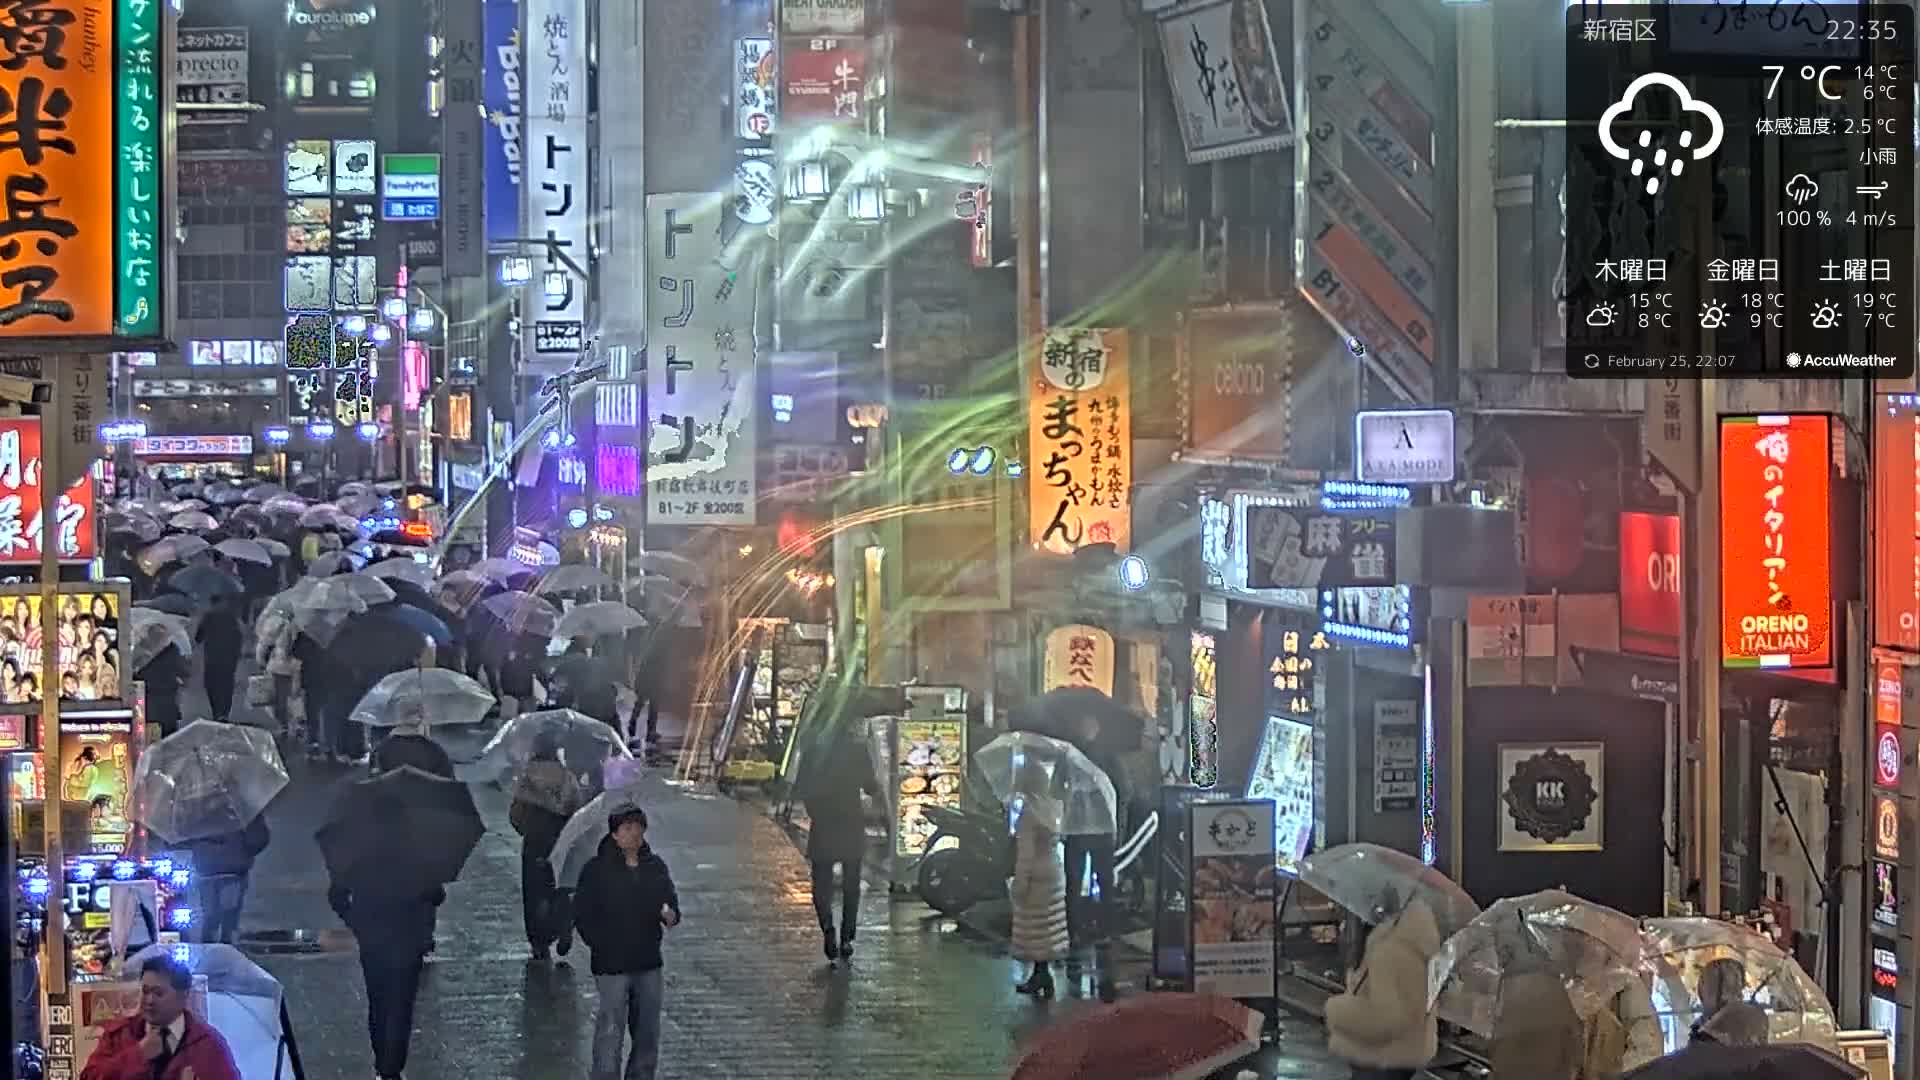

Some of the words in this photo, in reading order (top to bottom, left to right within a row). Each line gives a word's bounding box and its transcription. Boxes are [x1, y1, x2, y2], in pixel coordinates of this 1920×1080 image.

[832, 58, 859, 118] 牛門
[1394, 421, 1415, 449] A
[1042, 395, 1087, 544] まっちゃん
[1754, 431, 1788, 605] 俺のイタリアン
[1740, 614, 1809, 633] ORENO
[1740, 632, 1810, 652] ITALIAN
[1536, 782, 1565, 800] KK
